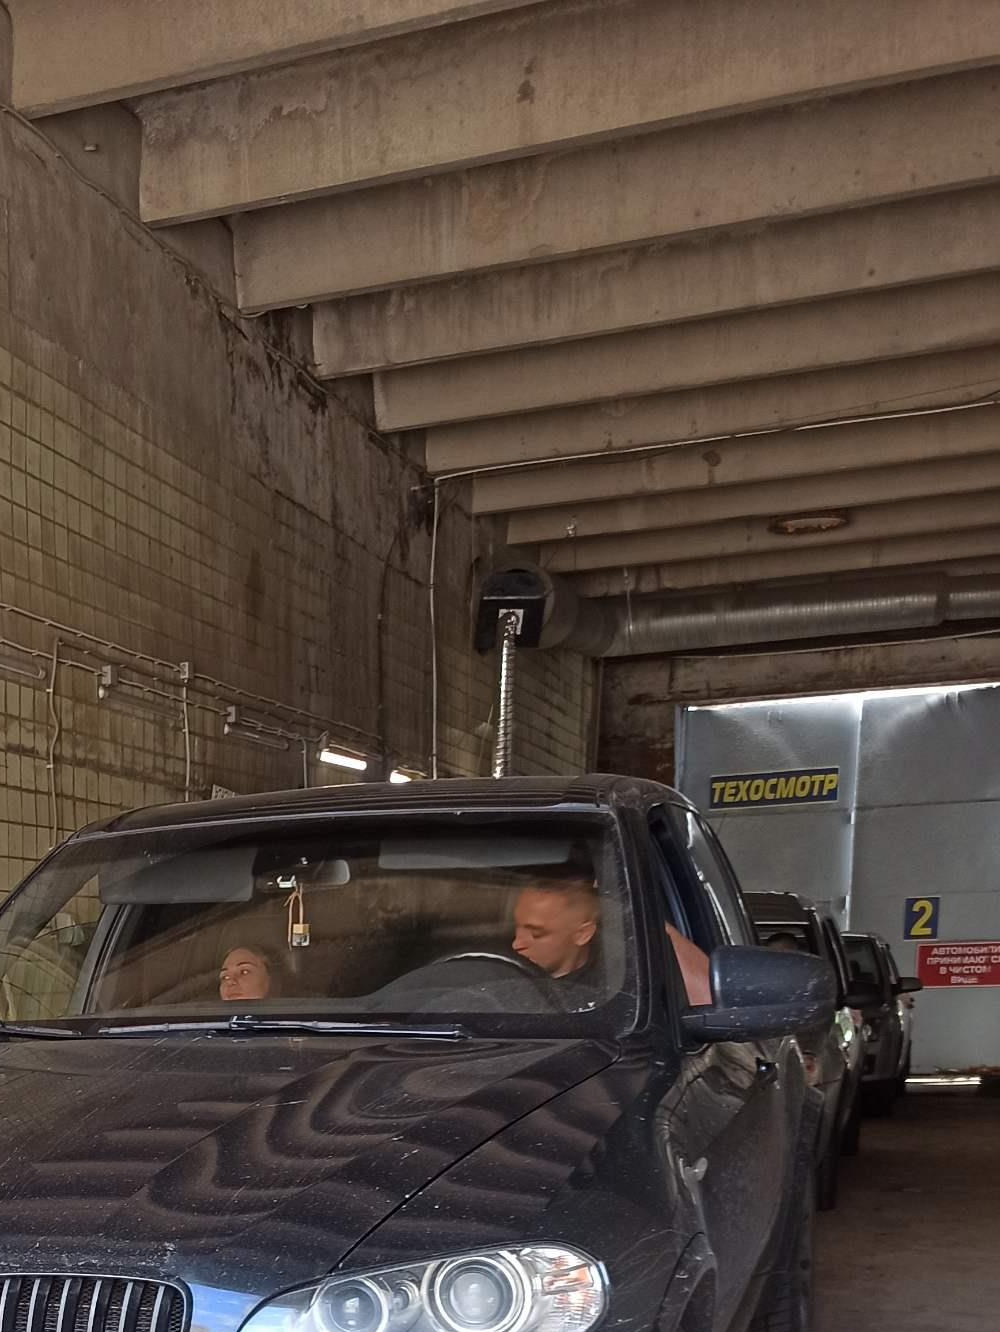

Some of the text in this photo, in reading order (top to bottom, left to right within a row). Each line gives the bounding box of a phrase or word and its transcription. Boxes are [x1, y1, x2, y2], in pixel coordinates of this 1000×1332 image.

[711, 774, 839, 804] ТЕХОСМОТР
[910, 900, 934, 936] 2
[926, 955, 1000, 965] ПРИНИМАЮТС
